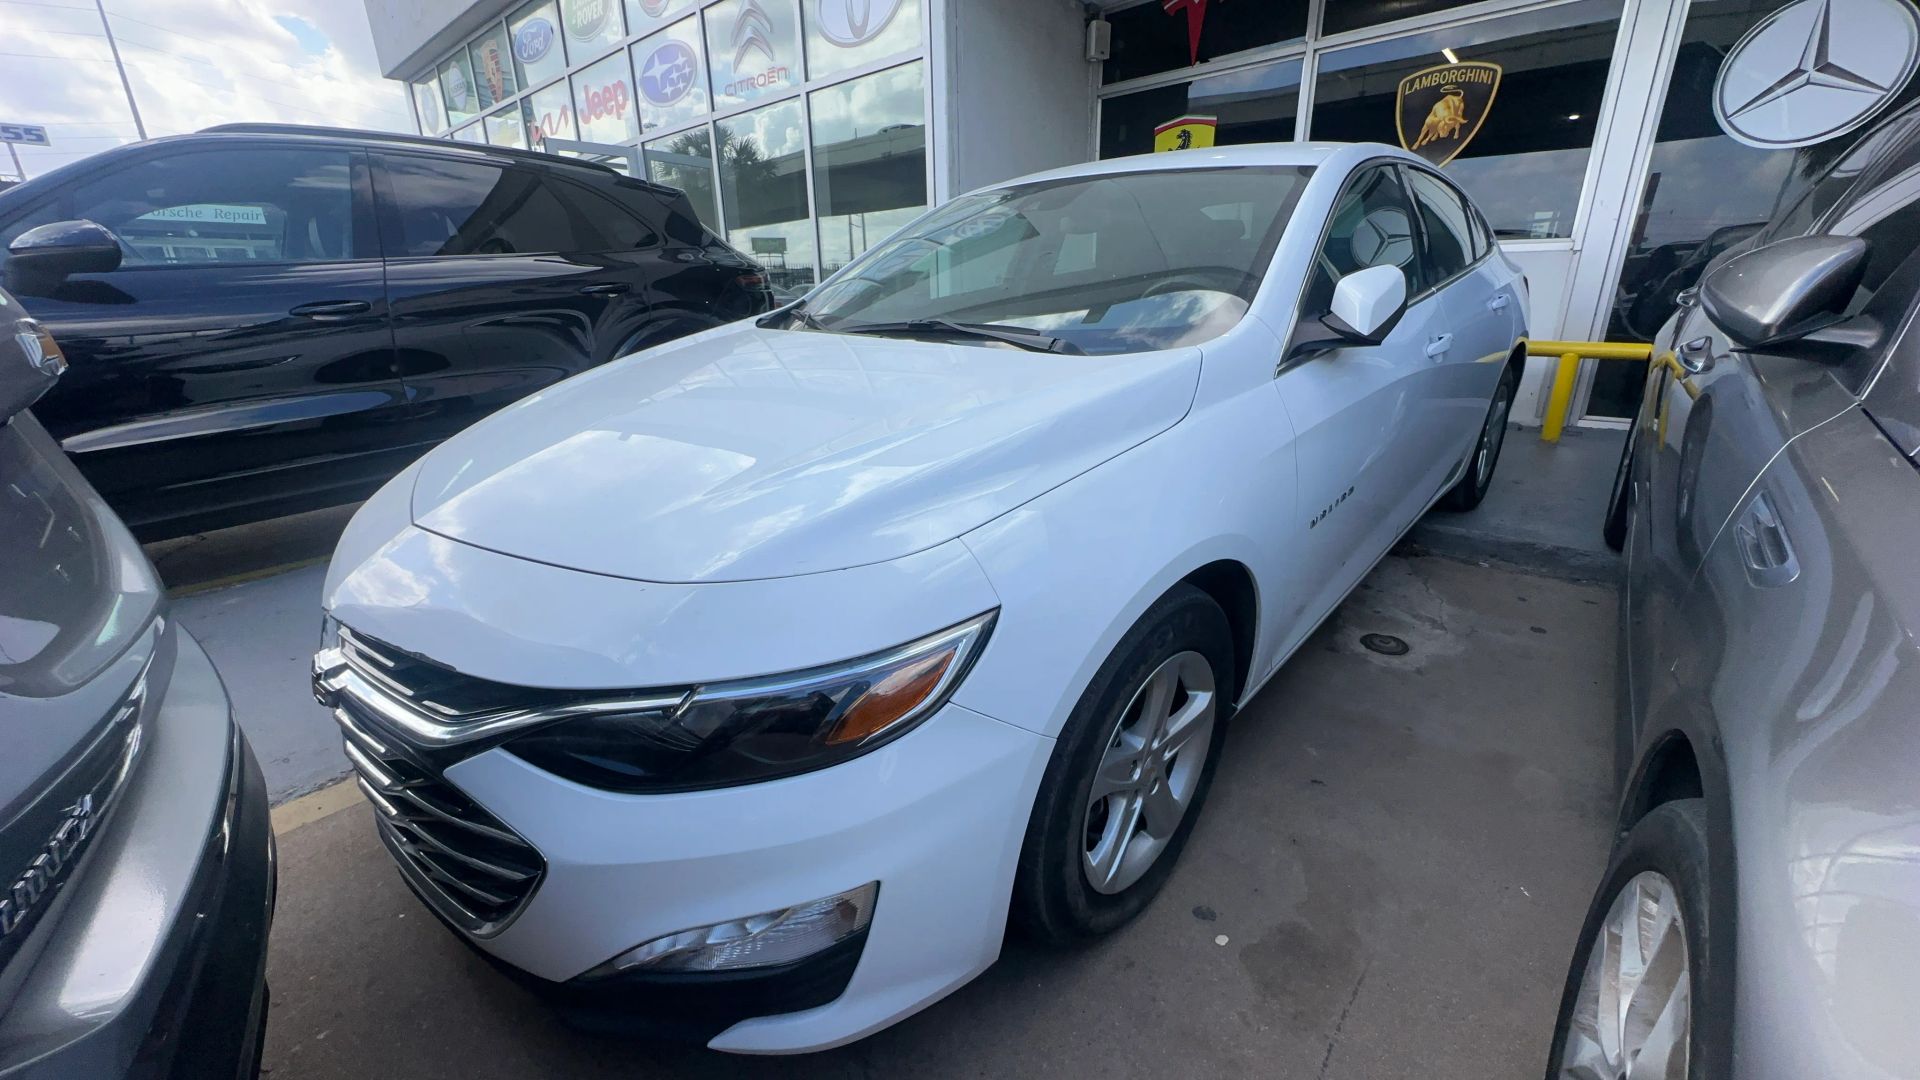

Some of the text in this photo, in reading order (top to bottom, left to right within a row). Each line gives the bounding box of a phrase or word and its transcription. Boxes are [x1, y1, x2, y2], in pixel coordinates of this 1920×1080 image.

[575, 1, 604, 28] ROVER
[523, 28, 544, 57] Ford
[1404, 68, 1494, 95] LAMBORGHINI
[579, 79, 630, 125] Jeep
[214, 208, 262, 223] Repair
